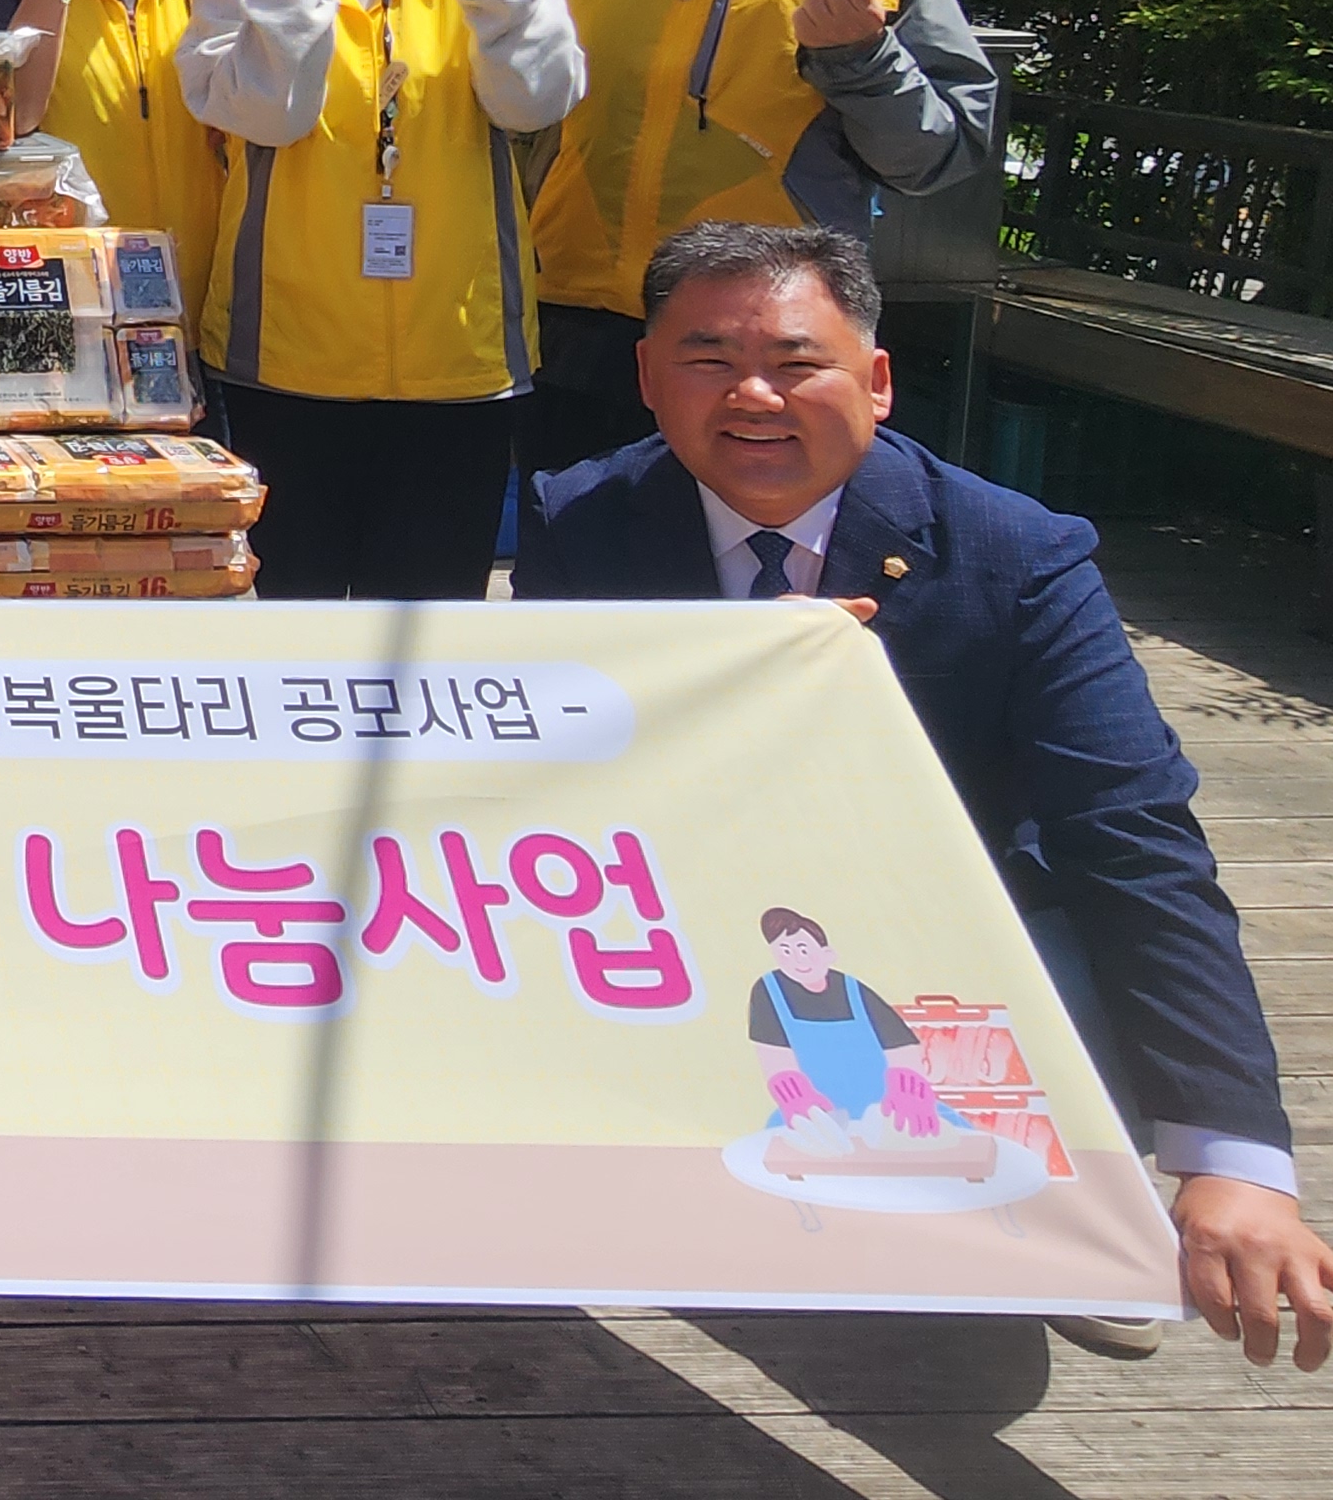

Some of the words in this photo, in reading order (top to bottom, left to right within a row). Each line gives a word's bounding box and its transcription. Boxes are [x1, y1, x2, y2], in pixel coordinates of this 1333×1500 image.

[3, 247, 32, 263] 양반
[68, 512, 136, 531] 들기름김
[282, 676, 540, 742] 공모사업
[24, 829, 693, 1009] 나눔사업
